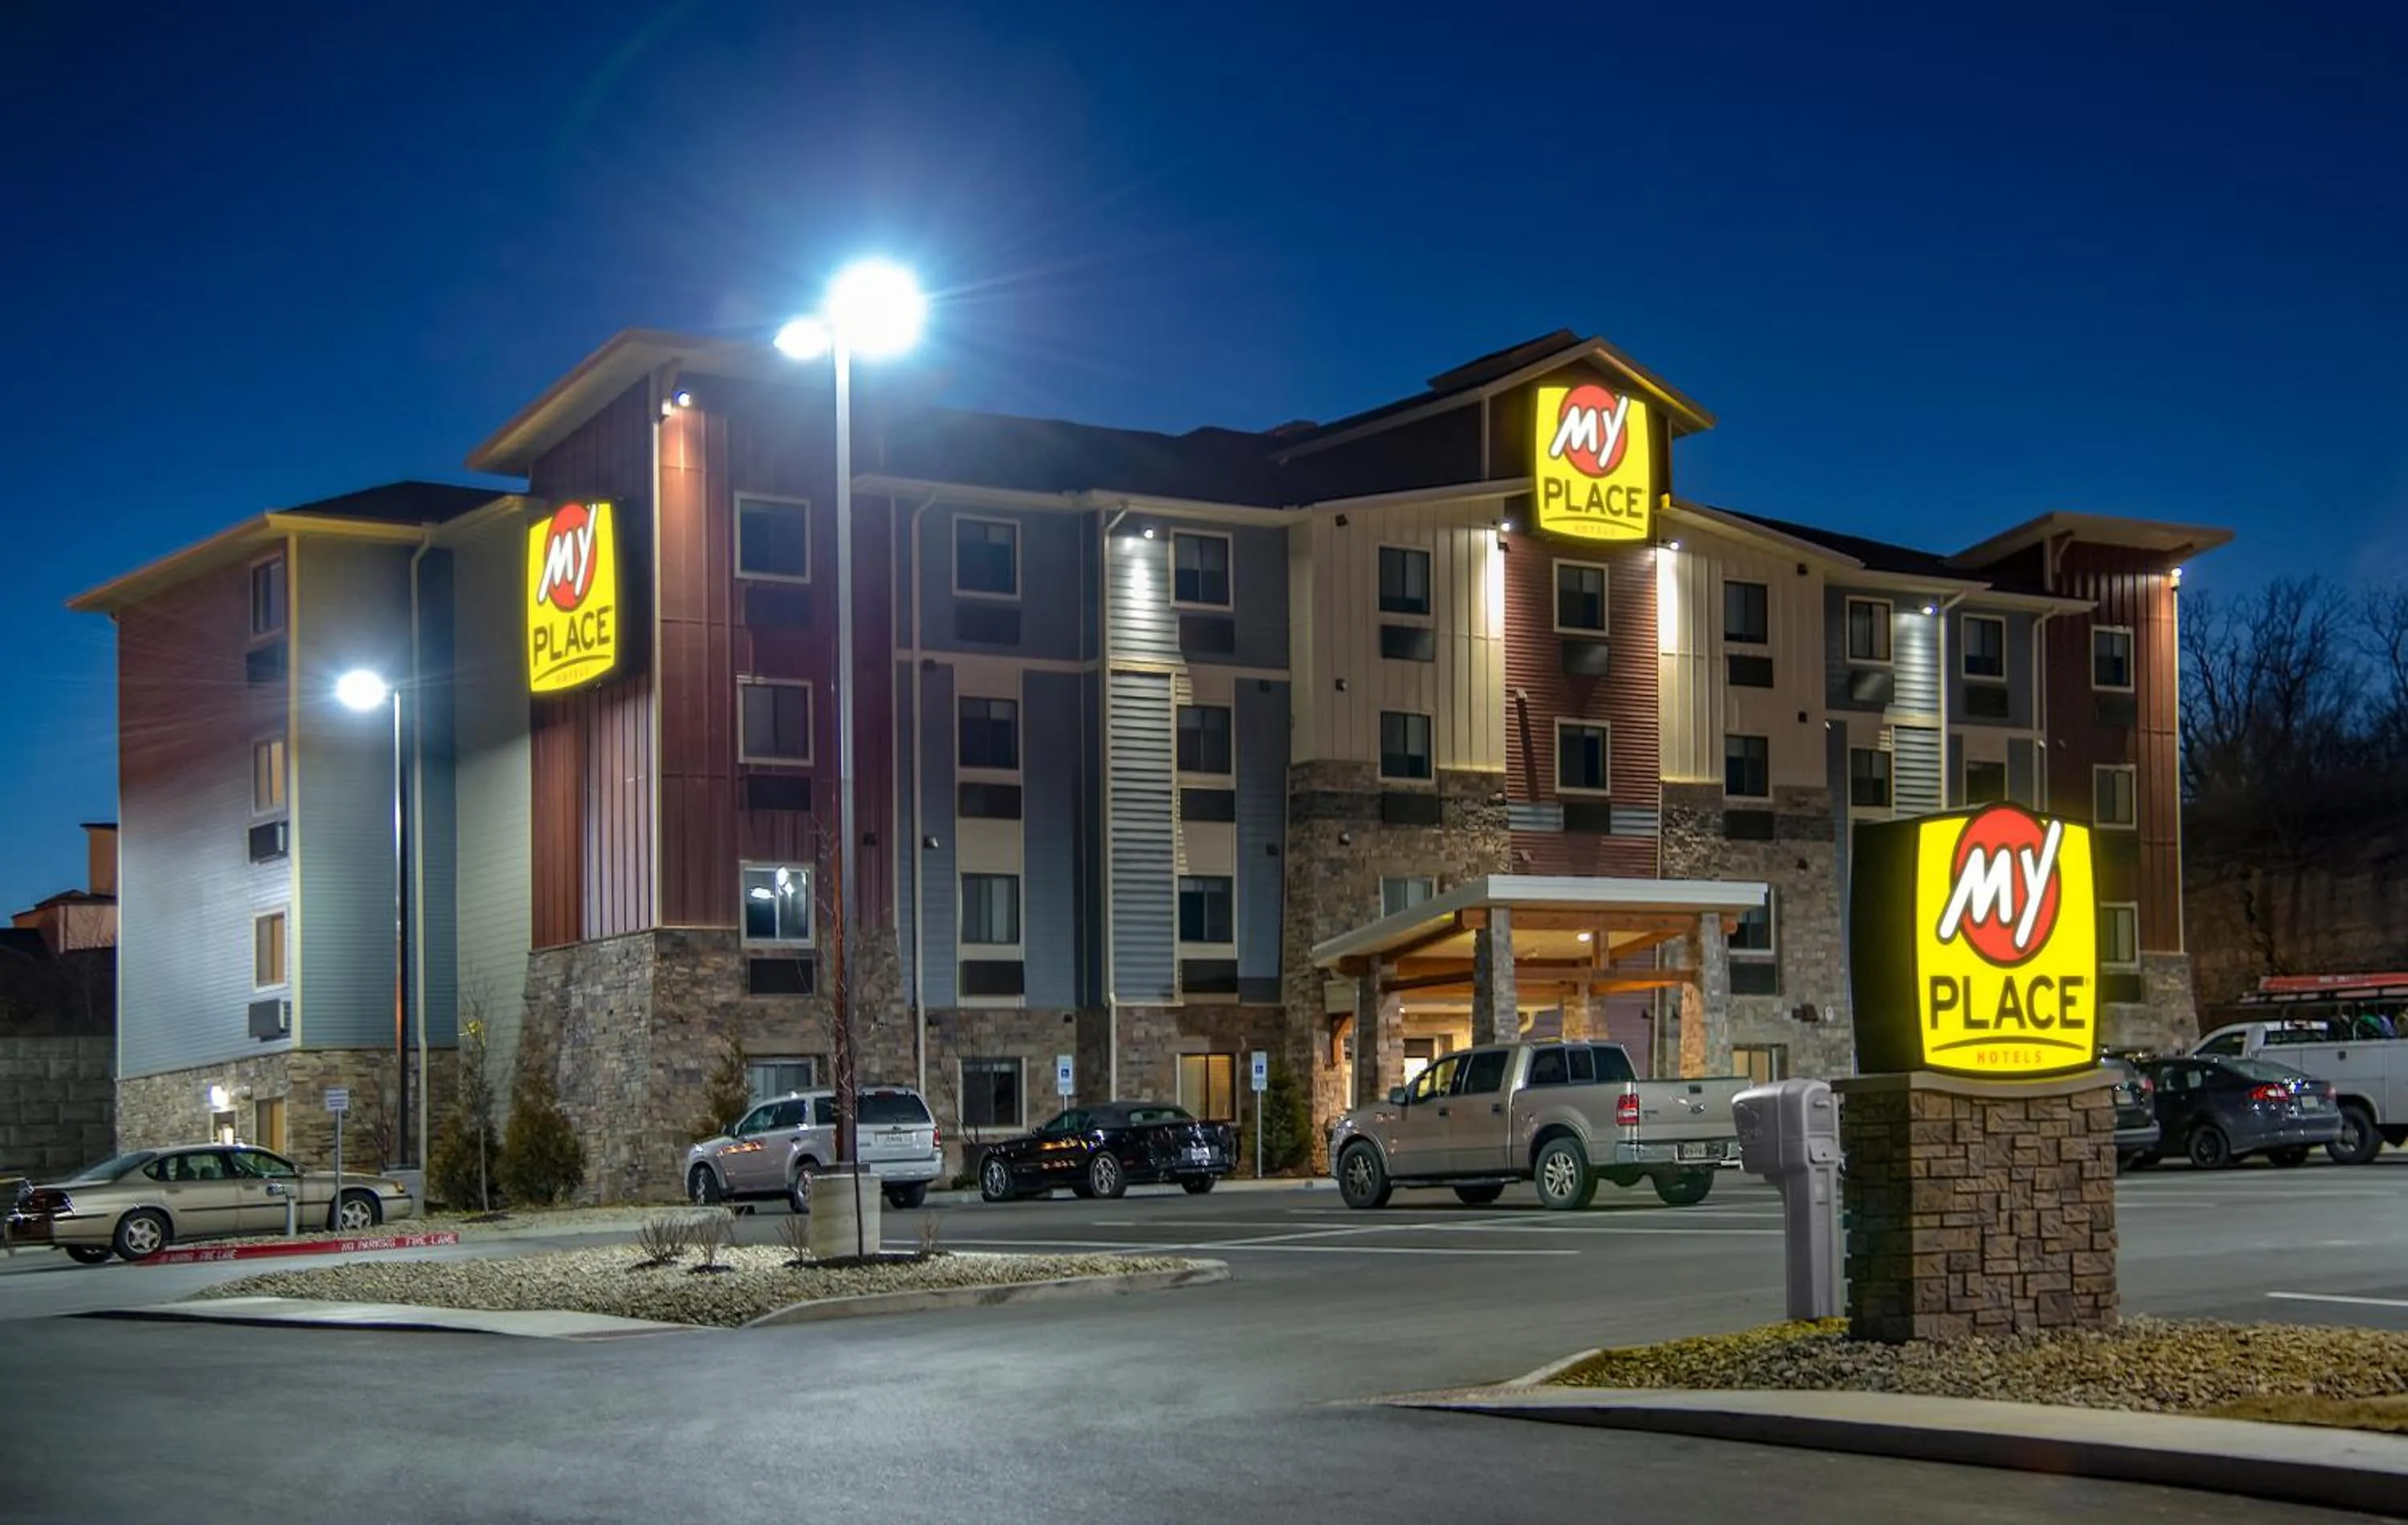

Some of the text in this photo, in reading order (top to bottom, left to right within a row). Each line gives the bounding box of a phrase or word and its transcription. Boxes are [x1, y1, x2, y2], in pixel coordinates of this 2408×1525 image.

[1548, 395, 1629, 470] MY
[1543, 477, 1644, 518] PLACE
[536, 502, 598, 604] MY
[533, 606, 612, 666] PLACE
[1937, 818, 2064, 950] MY
[1929, 975, 2085, 1031] PLACE
[1977, 1051, 2043, 1064] HOTELS
[358, 1238, 396, 1250] PARKING
[405, 1235, 426, 1246] FIRE
[430, 1232, 456, 1245] LANE
